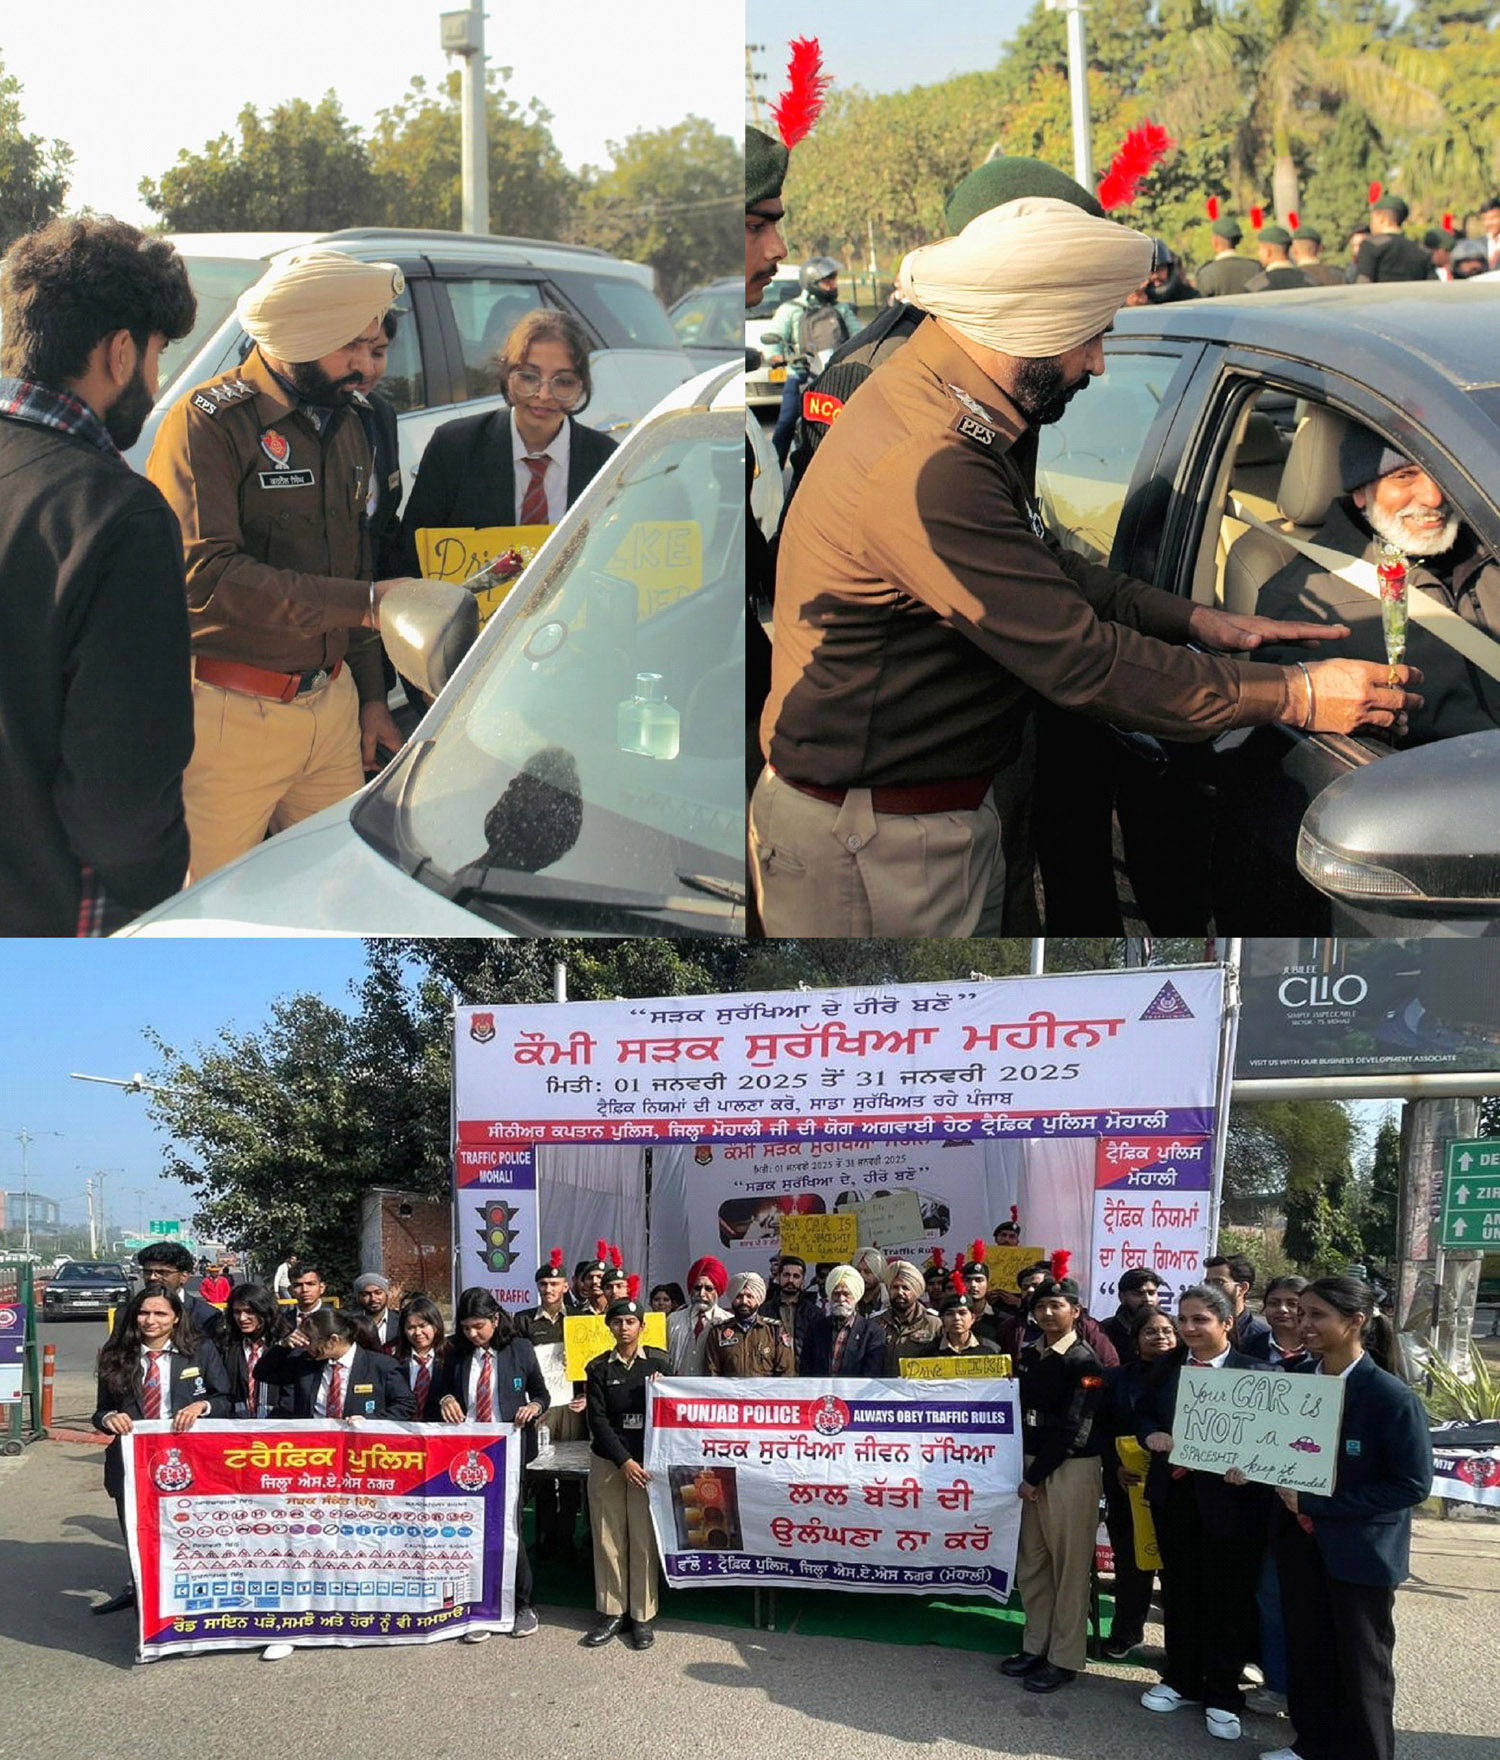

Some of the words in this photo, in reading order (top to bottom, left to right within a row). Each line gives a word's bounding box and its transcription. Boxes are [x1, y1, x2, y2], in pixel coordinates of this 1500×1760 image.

[1278, 974, 1367, 1007] CLIO
[717, 1002, 811, 1025] ਸੁਰੱਖਿਆ
[822, 1000, 842, 1016] ਦੇ
[854, 996, 900, 1015] ਹੀਰੋ
[513, 1030, 598, 1066] ਕੌਮੀ
[617, 1036, 724, 1064] ਸੜਕ
[746, 1021, 940, 1068] ਸੁਰੱਖਿਆ
[962, 1011, 1126, 1052] ਮਹੀਨਾ
[614, 1078, 640, 1092] 01
[652, 1072, 727, 1091] ਜਨਵਰੀ
[738, 1073, 808, 1090] 2025
[821, 1067, 845, 1087] ਤੋਂ
[857, 1071, 886, 1087] 31
[899, 1063, 986, 1084] ਜਨਵਰੀ
[1000, 1063, 1080, 1081] 2025
[642, 1097, 687, 1114] ਨਿਯਮਾਂ
[693, 1097, 711, 1112] ਦੀ
[717, 1099, 765, 1113] ਪਾਲਣਾ
[810, 1097, 845, 1111] ਸਾਡਾ
[967, 1089, 1013, 1106] ਪੰਜਾਬ
[488, 1123, 545, 1139] ਸੀਨੀਅਰ
[552, 1124, 604, 1138] ਕਪਤਾਨ
[712, 1119, 763, 1137] ਮੋਹਾਲੀ
[769, 1121, 789, 1137] ਜੀ
[797, 1119, 816, 1136] ਦੀ
[824, 1117, 854, 1135] ਯੋਗ
[862, 1115, 935, 1134] ਅਗਵਾਈ
[943, 1114, 973, 1133] ਹੇਠ
[1043, 1112, 1098, 1134] ਪੁਲਿਸ
[1105, 1110, 1170, 1130] ਮੋਹਾਲੀ
[461, 1151, 497, 1165] TRAFFIC
[499, 1151, 531, 1165] POLICE
[1157, 1141, 1203, 1163] ਪੁਲਿਸ
[479, 1170, 513, 1183] MOHALI
[1127, 1167, 1178, 1186] ਮੋਹਾਲੀ
[1151, 1200, 1200, 1229] ਨਿਯਮਾਂ
[1099, 1248, 1115, 1268] ਦਾ
[1153, 1241, 1199, 1271] ਗਿਆਨ
[494, 1289, 530, 1304] TRAFFIC
[1231, 1374, 1292, 1416] CAR
[1300, 1393, 1323, 1418] is
[676, 1404, 739, 1423] PUNJAB
[742, 1405, 801, 1424] POLICE
[853, 1408, 896, 1424] ALWAYS
[896, 1409, 925, 1424] OBEY
[925, 1410, 970, 1424] TRAFFIC
[970, 1410, 1006, 1425] RULES
[1183, 1403, 1256, 1446] NOT
[347, 1442, 427, 1473] ਪੁਲਿਸ
[701, 1438, 750, 1459] ਸੜਕ
[759, 1433, 846, 1464] ਸੁਰੱਖਿਆ
[854, 1435, 910, 1464] ਜੀਵਨ
[920, 1436, 995, 1465] ਰੱਖਿਆ
[1180, 1444, 1239, 1466] SPACESHIP
[1278, 1461, 1297, 1475] it
[367, 1477, 395, 1491] ਨਗਰ
[788, 1483, 849, 1507] ਲਾਲ
[864, 1476, 923, 1510] ਬੱਤੀ
[937, 1477, 974, 1512] ਦੀ
[770, 1515, 882, 1548] ਉਲੰਘਣਾ
[896, 1528, 931, 1551] ਨਾ
[944, 1523, 994, 1551] ਕਰੋ
[904, 1570, 934, 1581] ਨਗਰ
[173, 1616, 198, 1632] ਰੋਡ
[204, 1614, 249, 1629] ਸਾਇਨ
[321, 1612, 344, 1627] ਅਤੇ
